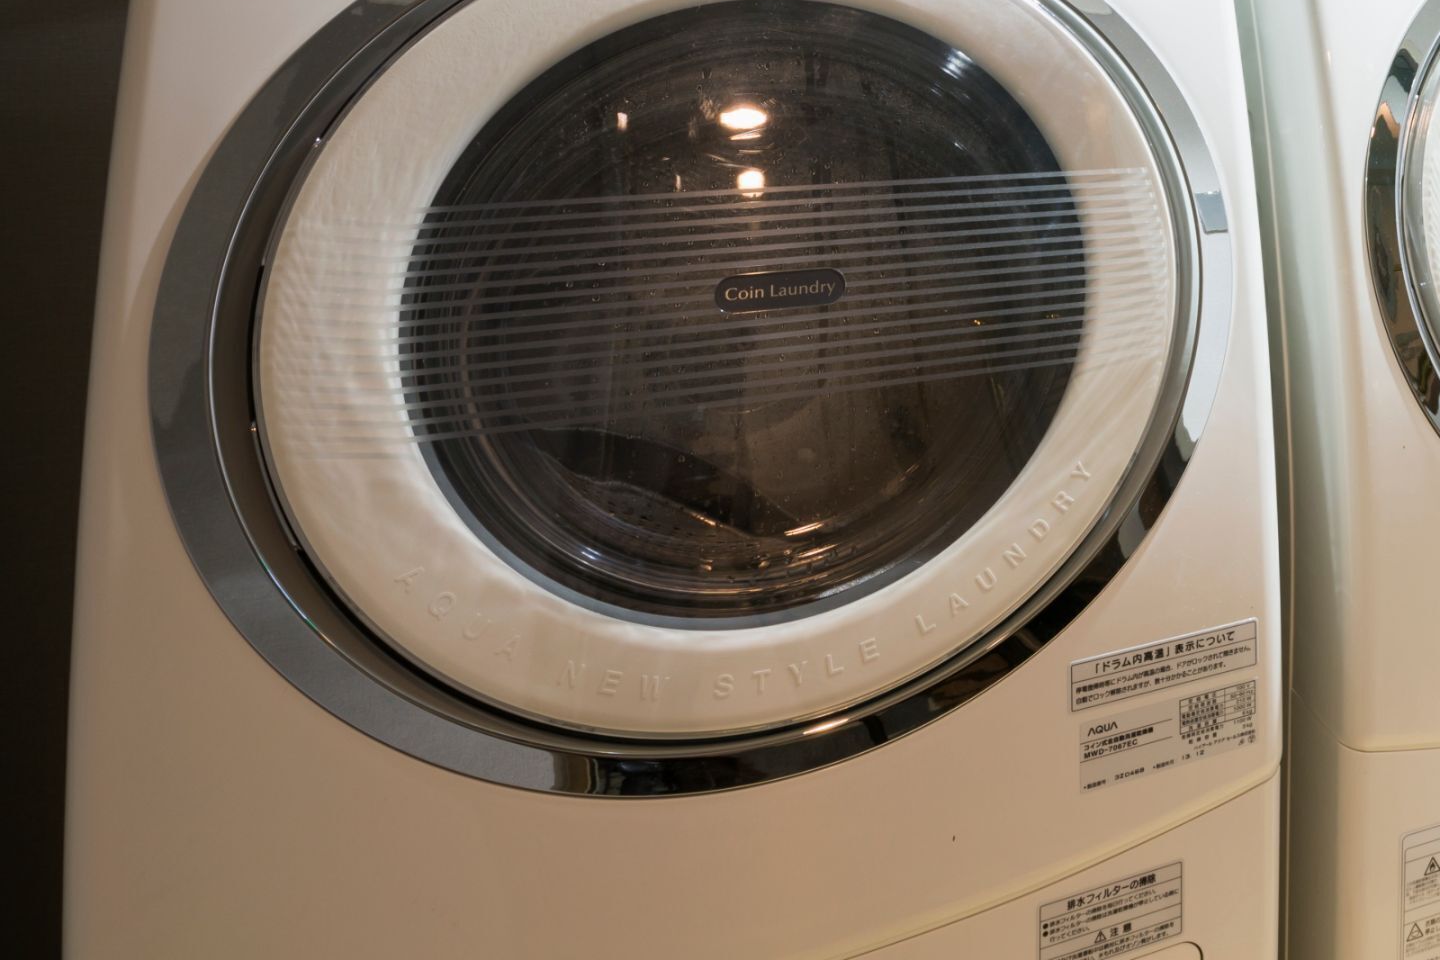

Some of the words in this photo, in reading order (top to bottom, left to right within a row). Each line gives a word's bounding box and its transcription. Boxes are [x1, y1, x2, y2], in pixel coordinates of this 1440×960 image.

[724, 286, 765, 301] Coin
[770, 280, 836, 297] Laundry
[558, 658, 673, 702] NEW
[712, 637, 880, 700] STYLE
[915, 459, 1094, 634] LAUNDRY
[1095, 631, 1236, 674] 「ドラム内高温」表示について
[1087, 721, 1119, 737] AQUA
